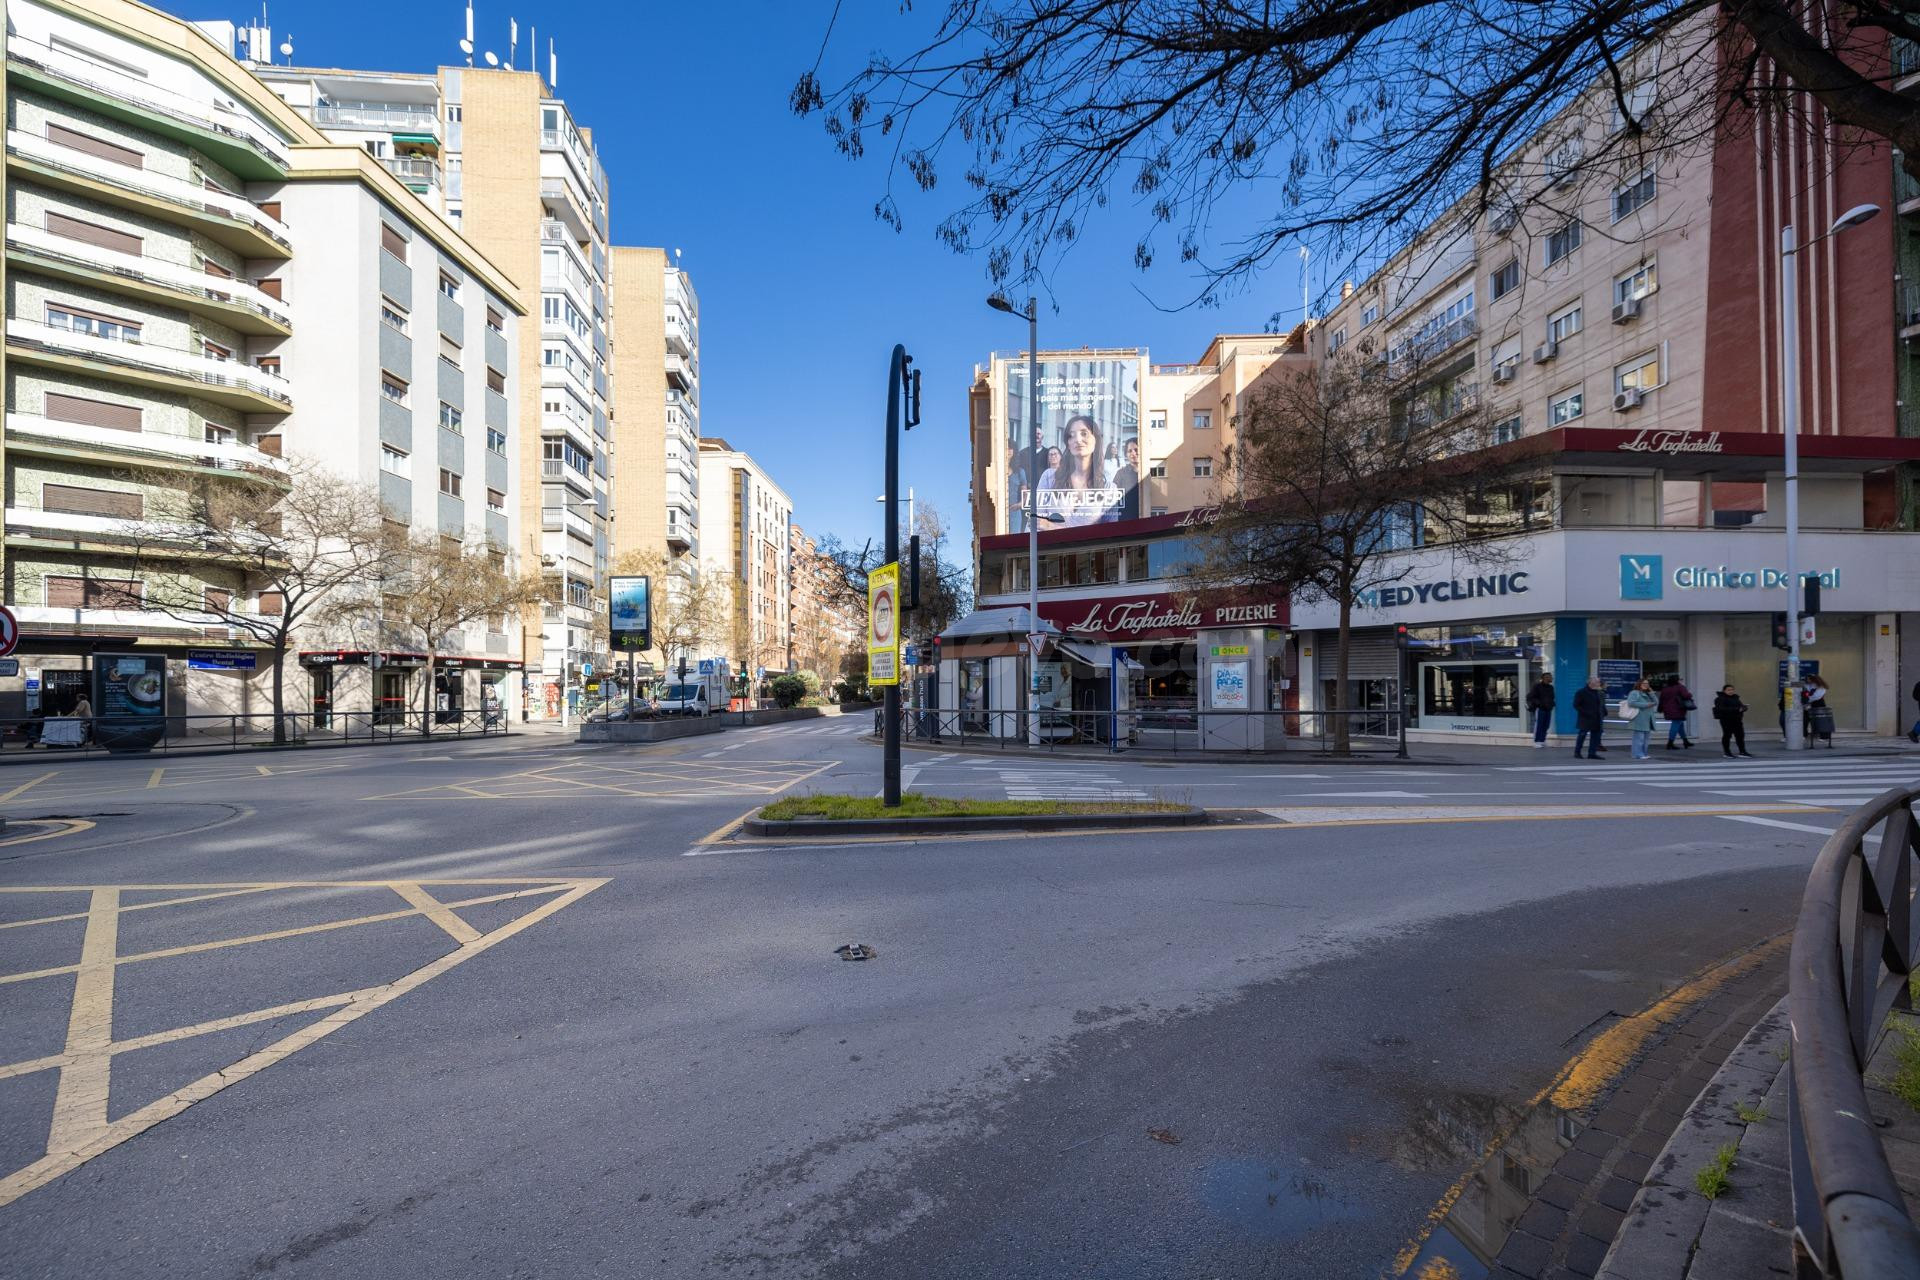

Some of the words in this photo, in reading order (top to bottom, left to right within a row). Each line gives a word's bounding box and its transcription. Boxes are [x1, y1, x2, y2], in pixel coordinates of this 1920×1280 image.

[1065, 376, 1110, 388] preparado
[1047, 386, 1066, 395] para
[1080, 393, 1114, 404] longevo
[1047, 402, 1061, 410] del
[1617, 429, 1649, 452] La
[1648, 430, 1723, 456] Tagliatella
[1673, 565, 1756, 589] Clínica
[1066, 602, 1103, 633] La
[1102, 596, 1202, 635] Tagliatella
[1215, 603, 1278, 623] PIZZERIE
[621, 636, 645, 646] 9:46
[1216, 676, 1243, 690] PADRE
